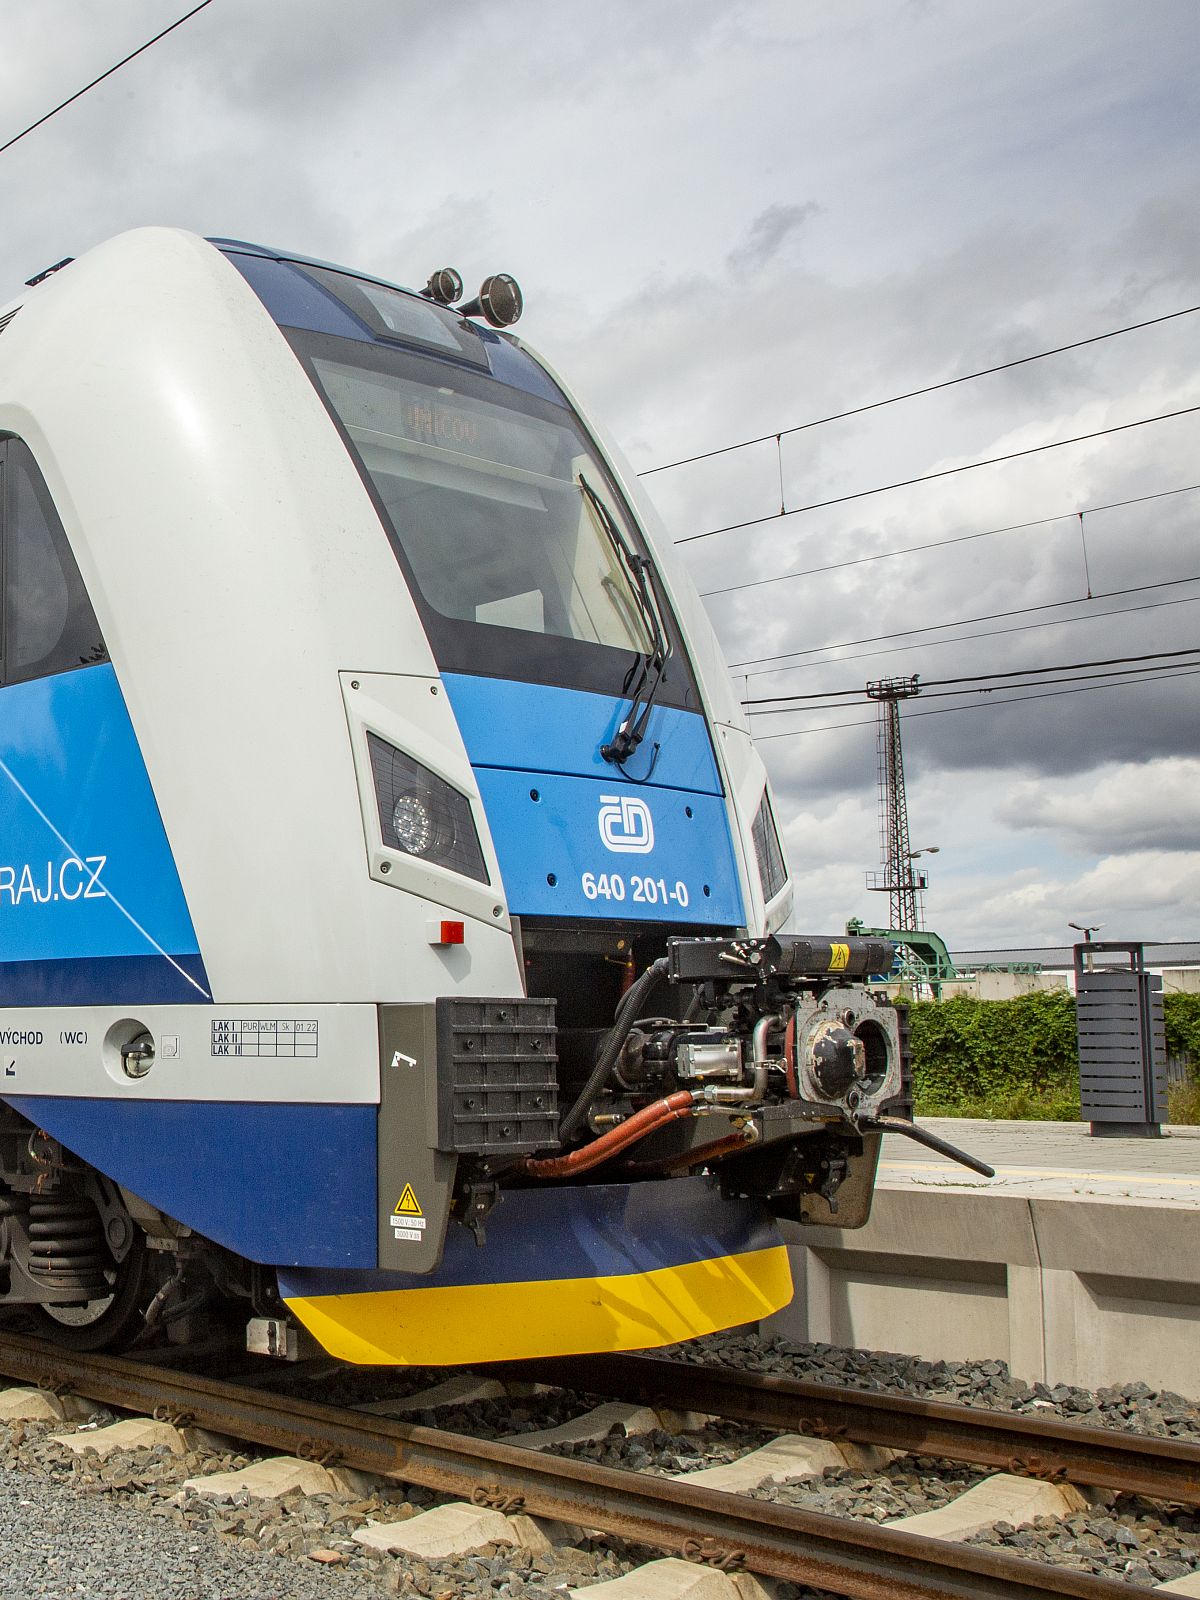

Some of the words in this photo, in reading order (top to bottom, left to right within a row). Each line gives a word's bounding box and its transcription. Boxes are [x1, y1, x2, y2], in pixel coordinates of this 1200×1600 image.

[581, 872, 625, 901] 640
[630, 875, 689, 907] 201-0
[213, 1021, 230, 1031] LAK
[242, 1022, 258, 1031] PUR
[0, 1027, 43, 1045] VÝCHOD
[59, 1030, 88, 1045] (WC)
[213, 1033, 229, 1043] LAK
[212, 1045, 229, 1055] LAK
